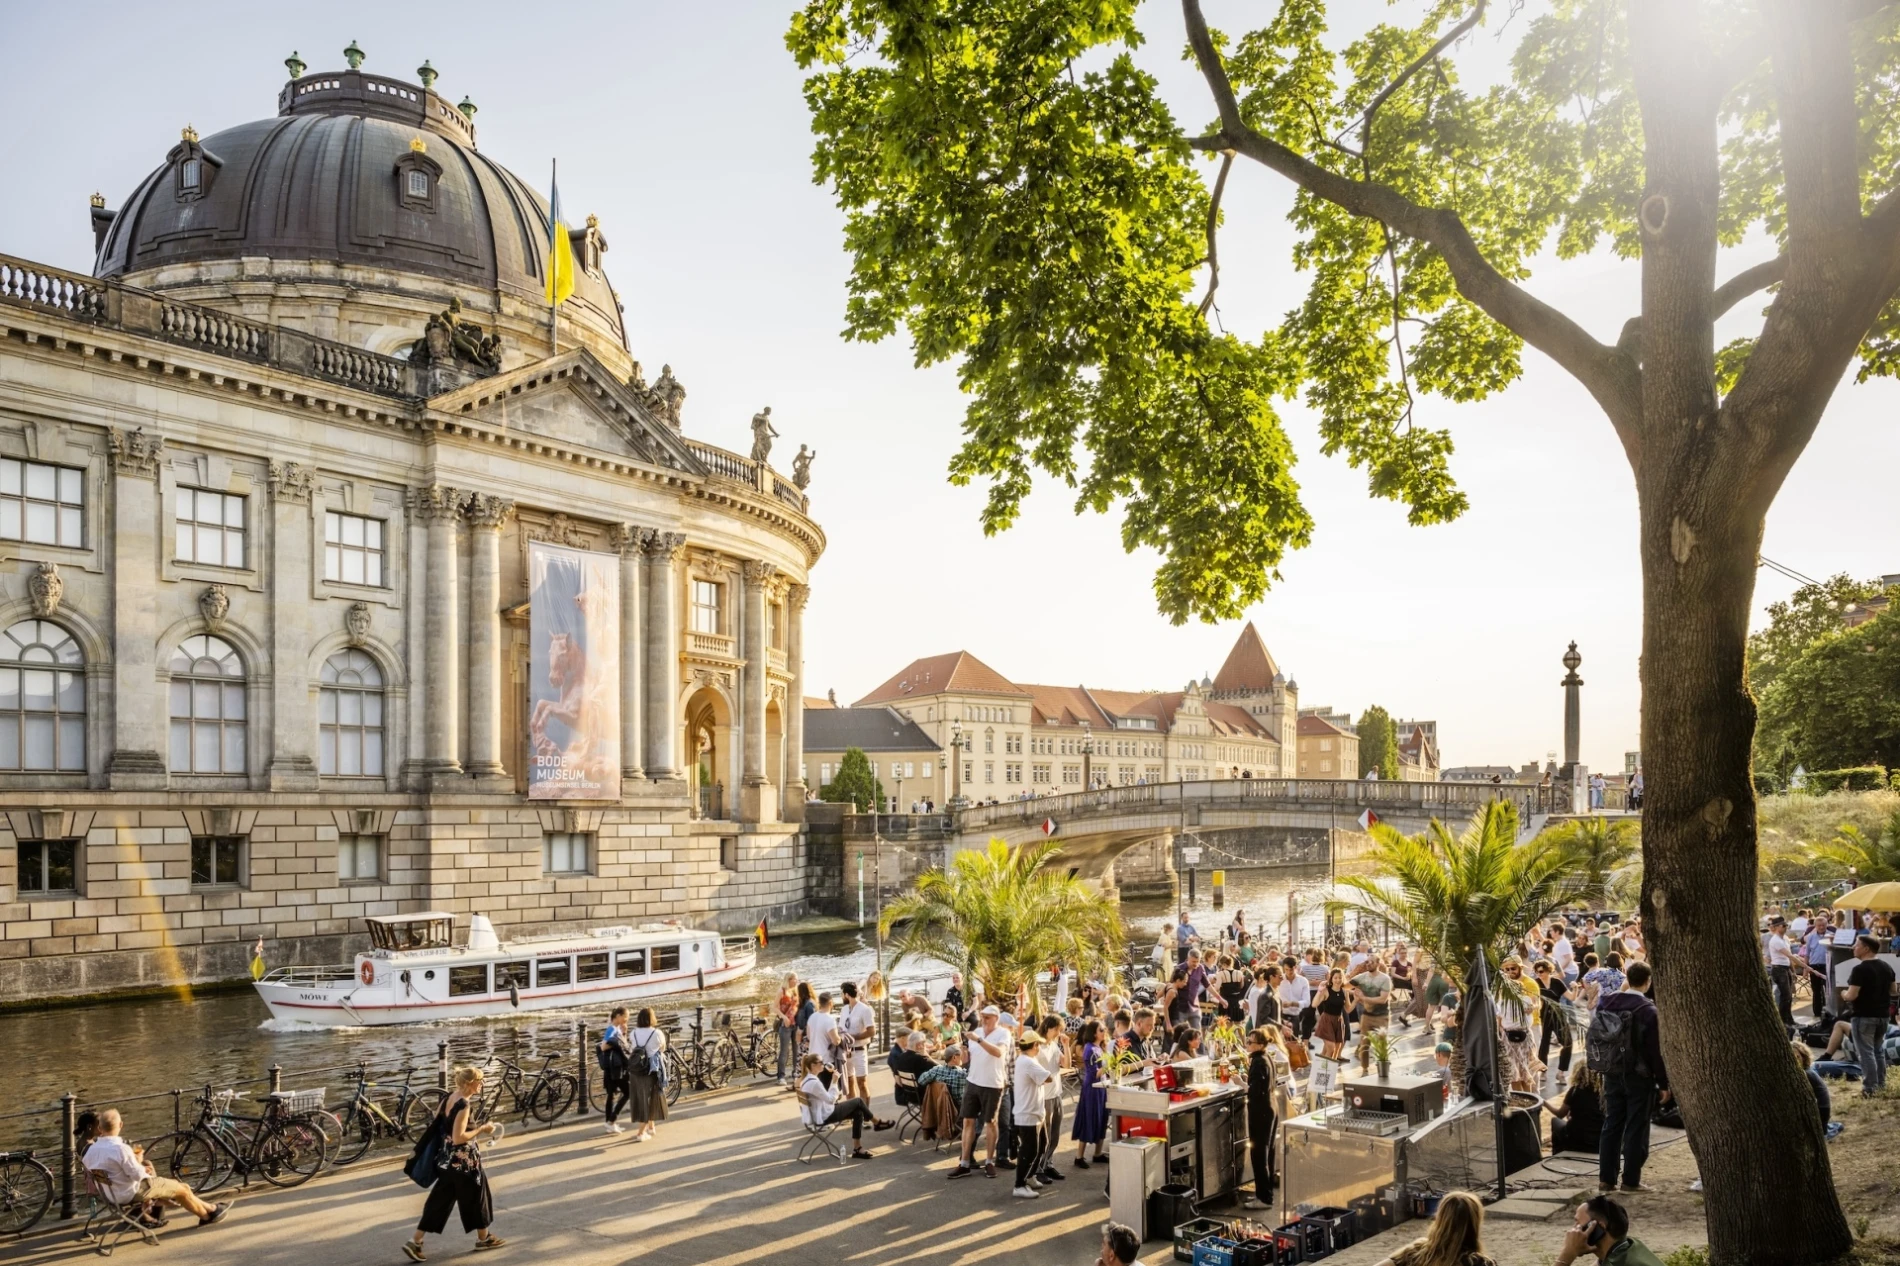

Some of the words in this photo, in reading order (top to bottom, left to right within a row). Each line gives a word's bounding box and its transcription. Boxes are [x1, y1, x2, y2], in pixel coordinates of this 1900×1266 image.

[537, 755, 567, 767] BODE
[536, 768, 585, 780] MUSEUM
[300, 992, 329, 1001] MÖWE
